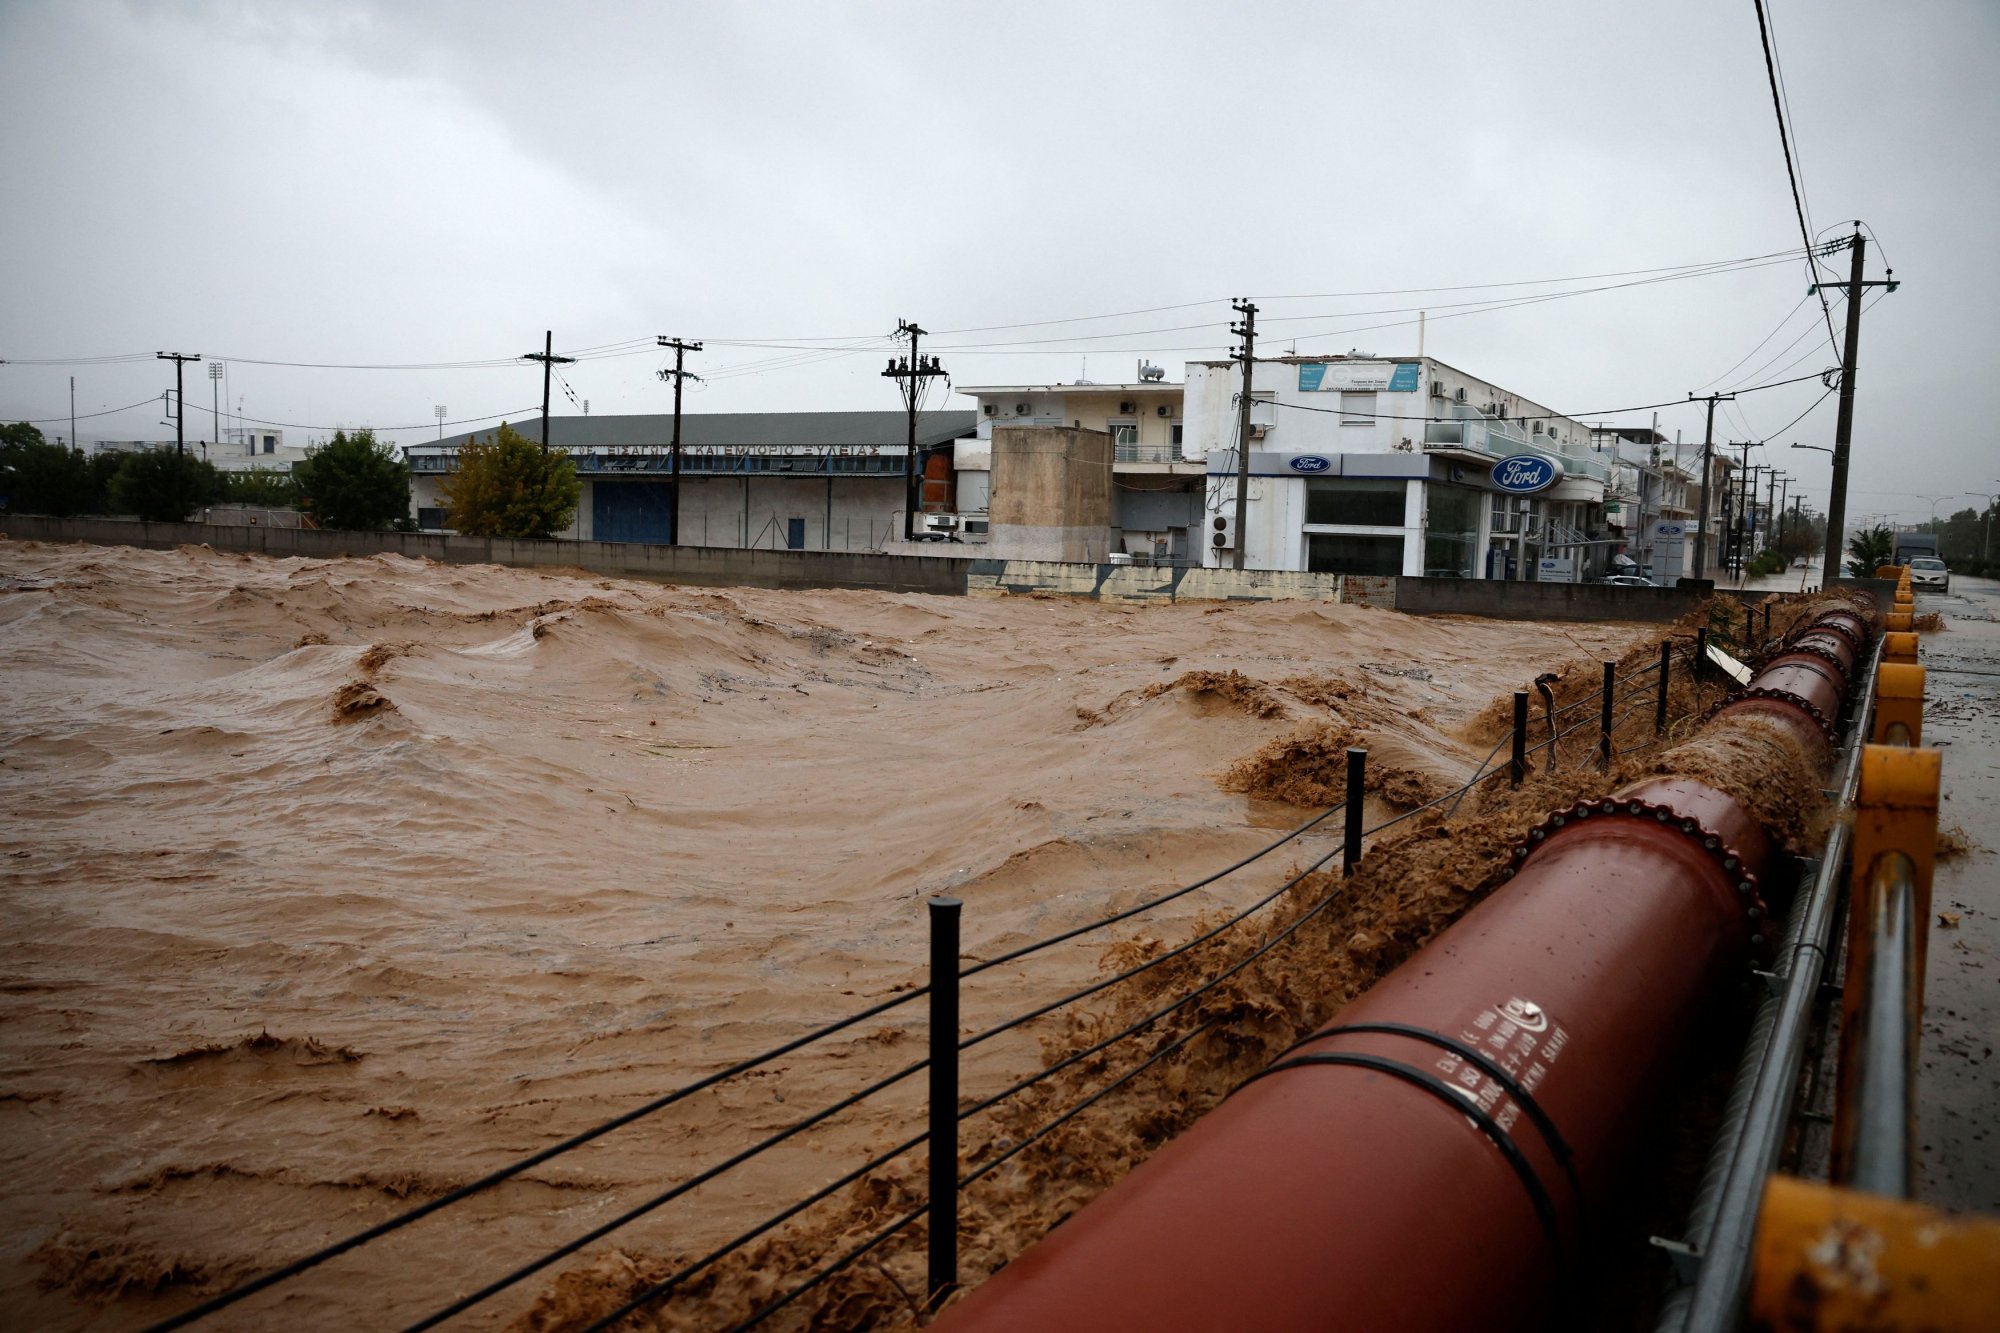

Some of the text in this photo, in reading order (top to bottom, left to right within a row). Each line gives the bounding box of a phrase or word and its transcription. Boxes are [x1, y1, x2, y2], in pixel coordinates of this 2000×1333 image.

[725, 446, 794, 456] ΕΜΠΟΡΙΟ
[1296, 458, 1322, 470] Ford
[1502, 460, 1541, 486] Ford
